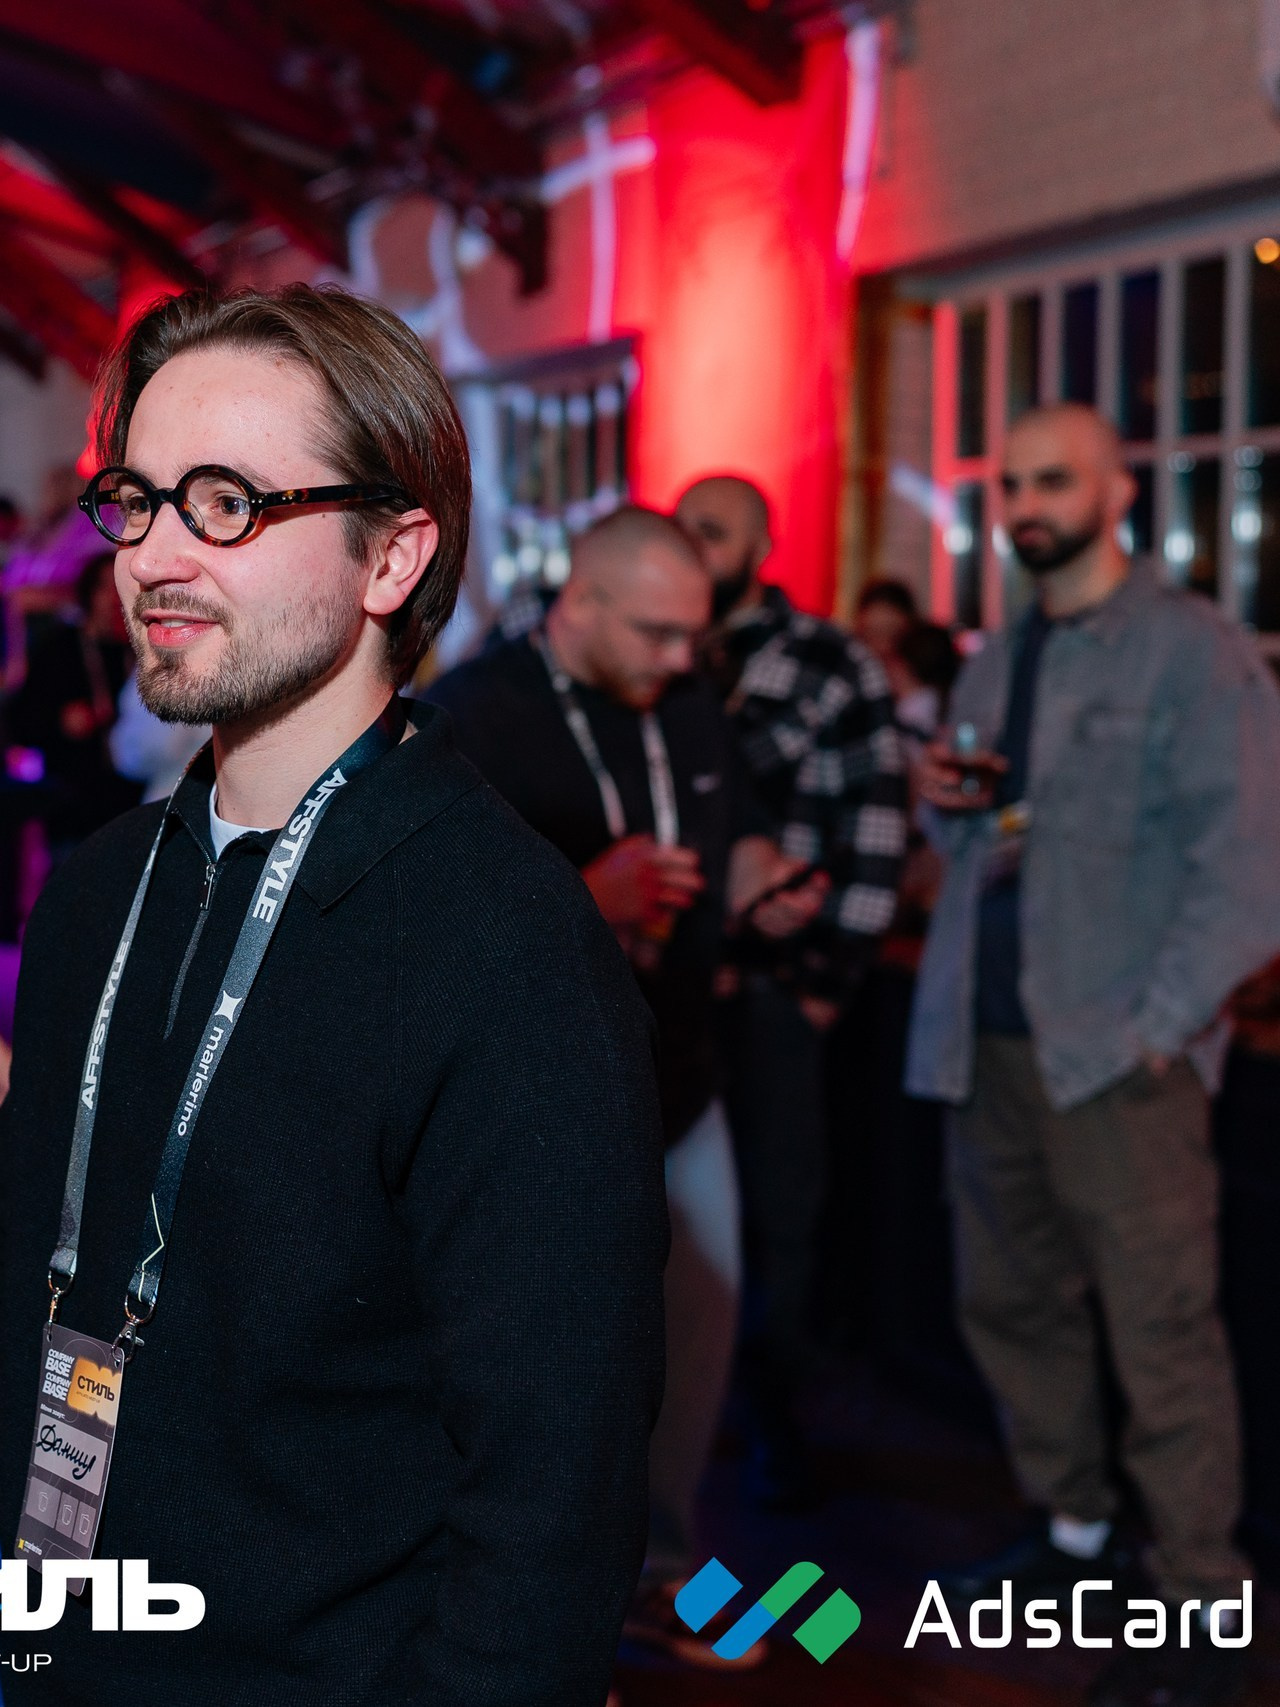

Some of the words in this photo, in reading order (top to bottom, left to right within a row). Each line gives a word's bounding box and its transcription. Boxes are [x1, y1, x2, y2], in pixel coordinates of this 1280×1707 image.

[252, 768, 349, 923] AFFSTYLE
[81, 941, 130, 1110] AFFSTYLE
[178, 1026, 225, 1136] marlerino
[45, 1356, 72, 1377] BASE
[48, 1348, 75, 1364] COMPANY
[42, 1380, 68, 1401] BASE
[77, 1375, 115, 1402] СТИЛЬ
